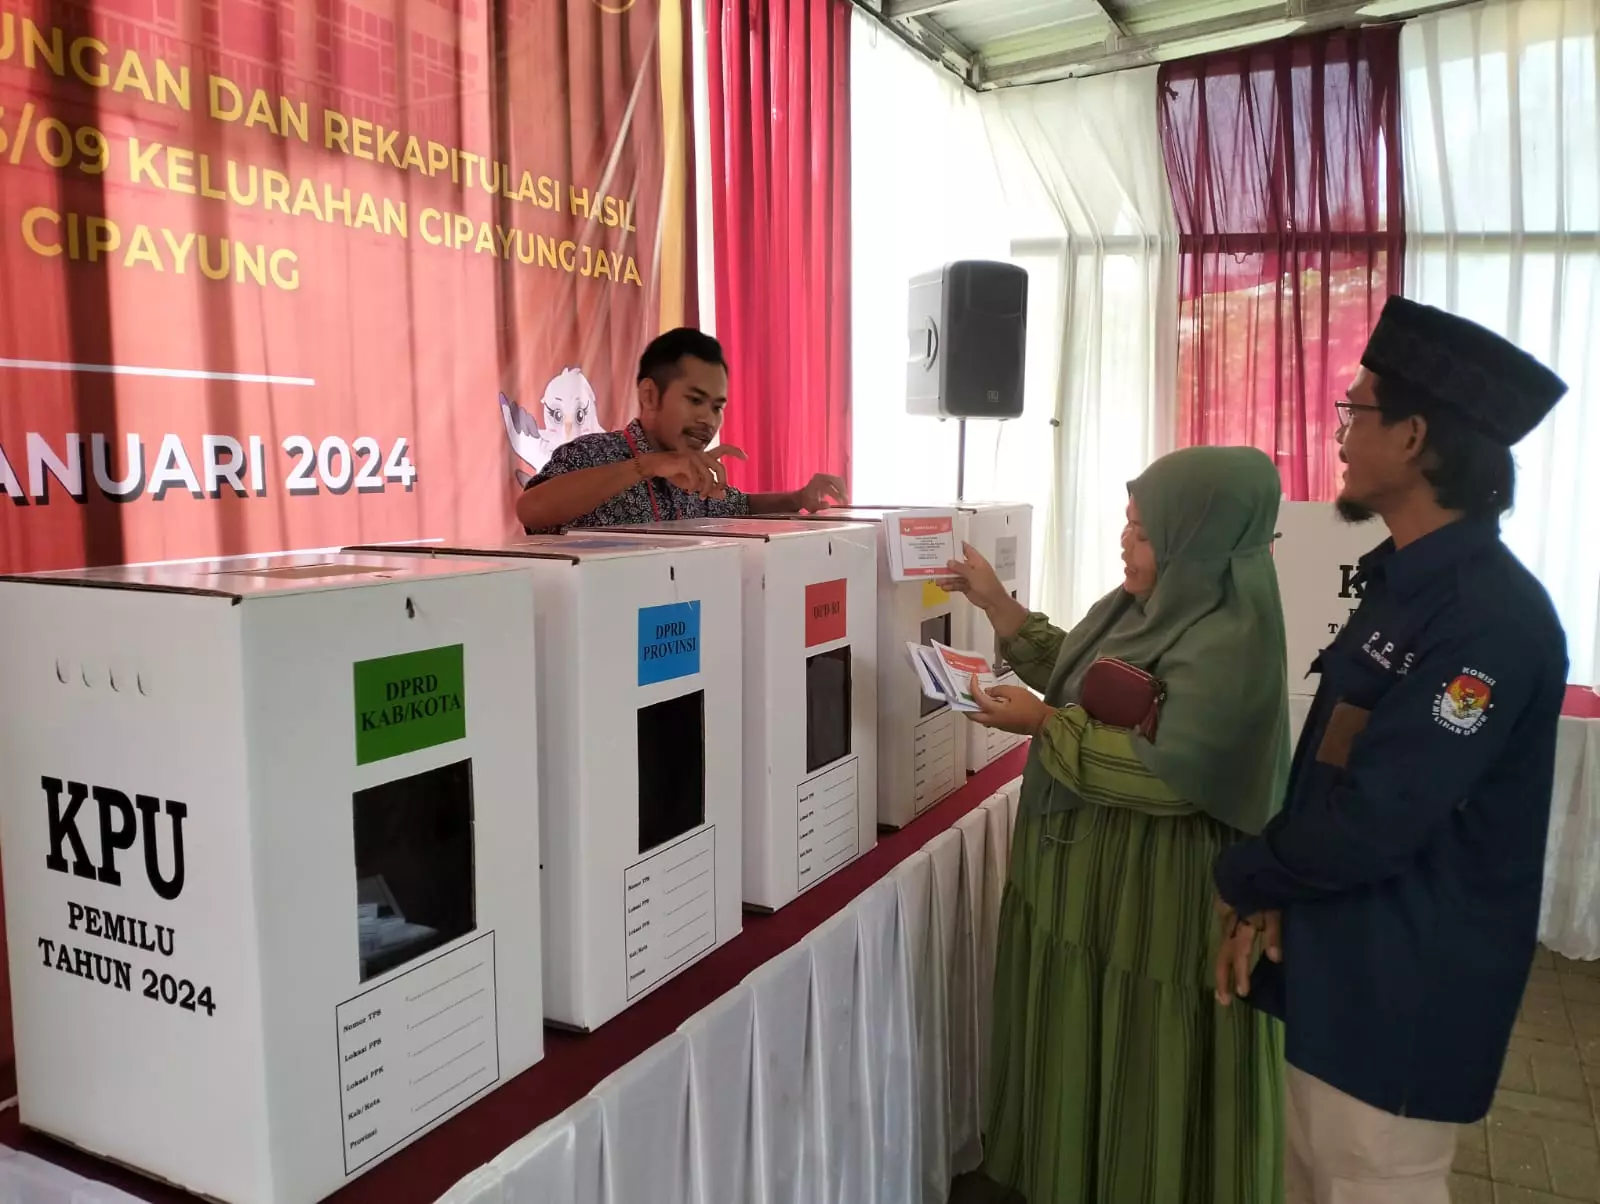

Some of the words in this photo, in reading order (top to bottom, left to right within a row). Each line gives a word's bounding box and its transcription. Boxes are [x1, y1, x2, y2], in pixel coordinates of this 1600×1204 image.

[210, 74, 308, 143] DAN
[324, 108, 560, 213] REKAPITULASI
[570, 185, 636, 233] HASIL
[128, 136, 407, 239] KELURAHAN
[419, 207, 576, 274] CIPAYUNG
[579, 243, 643, 288] JAYA
[21, 206, 299, 291] CIPAYUNG
[284, 435, 416, 497] 2024
[643, 637, 697, 661] PROVINSI
[655, 621, 686, 640] DPRD
[385, 674, 438, 702] DPRD
[1462, 667, 1497, 686] KOMISI
[361, 694, 462, 733] KAB/KOTA
[41, 775, 188, 900] KPU
[67, 901, 175, 957] PEMILU
[37, 937, 132, 992] TAHUN
[142, 968, 217, 1017] 2024
